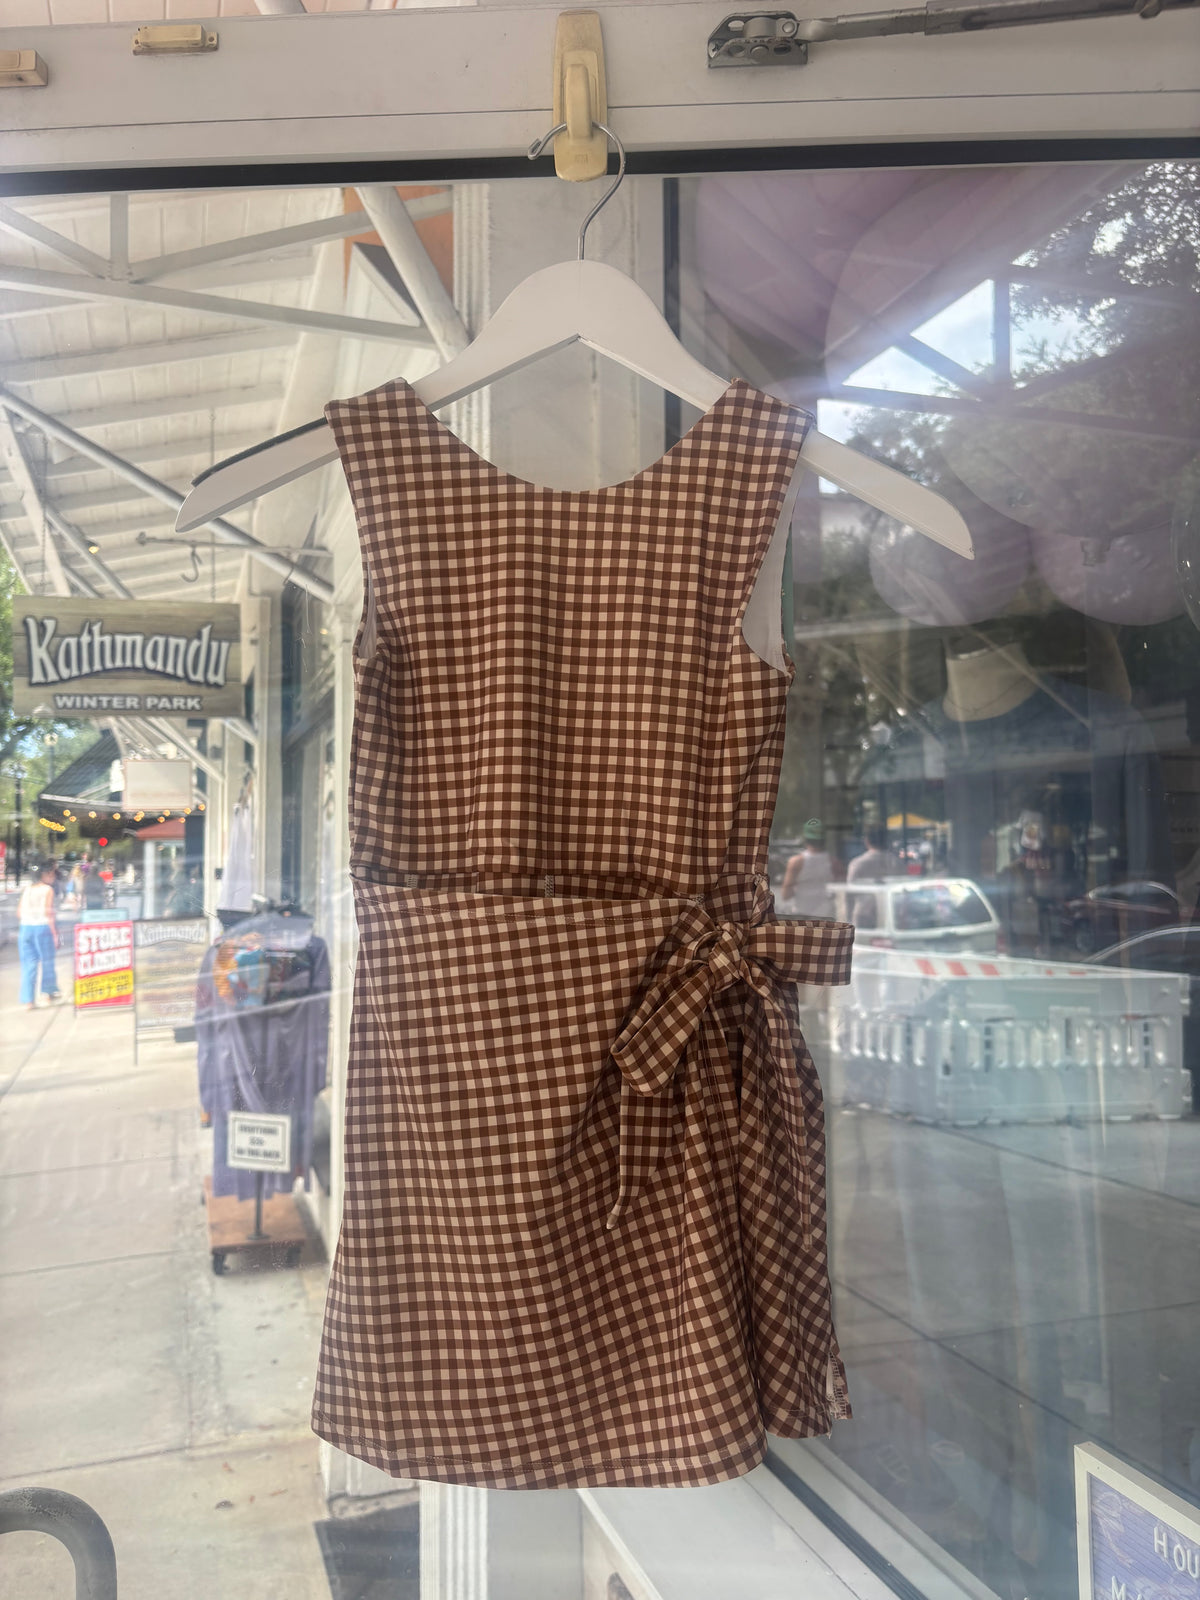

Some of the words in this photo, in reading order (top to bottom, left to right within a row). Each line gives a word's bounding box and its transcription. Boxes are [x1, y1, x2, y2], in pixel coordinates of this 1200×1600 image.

[25, 616, 230, 686] Kathmandu
[55, 695, 140, 710] WINTER
[146, 696, 202, 711] PARK
[78, 926, 131, 955] STORE
